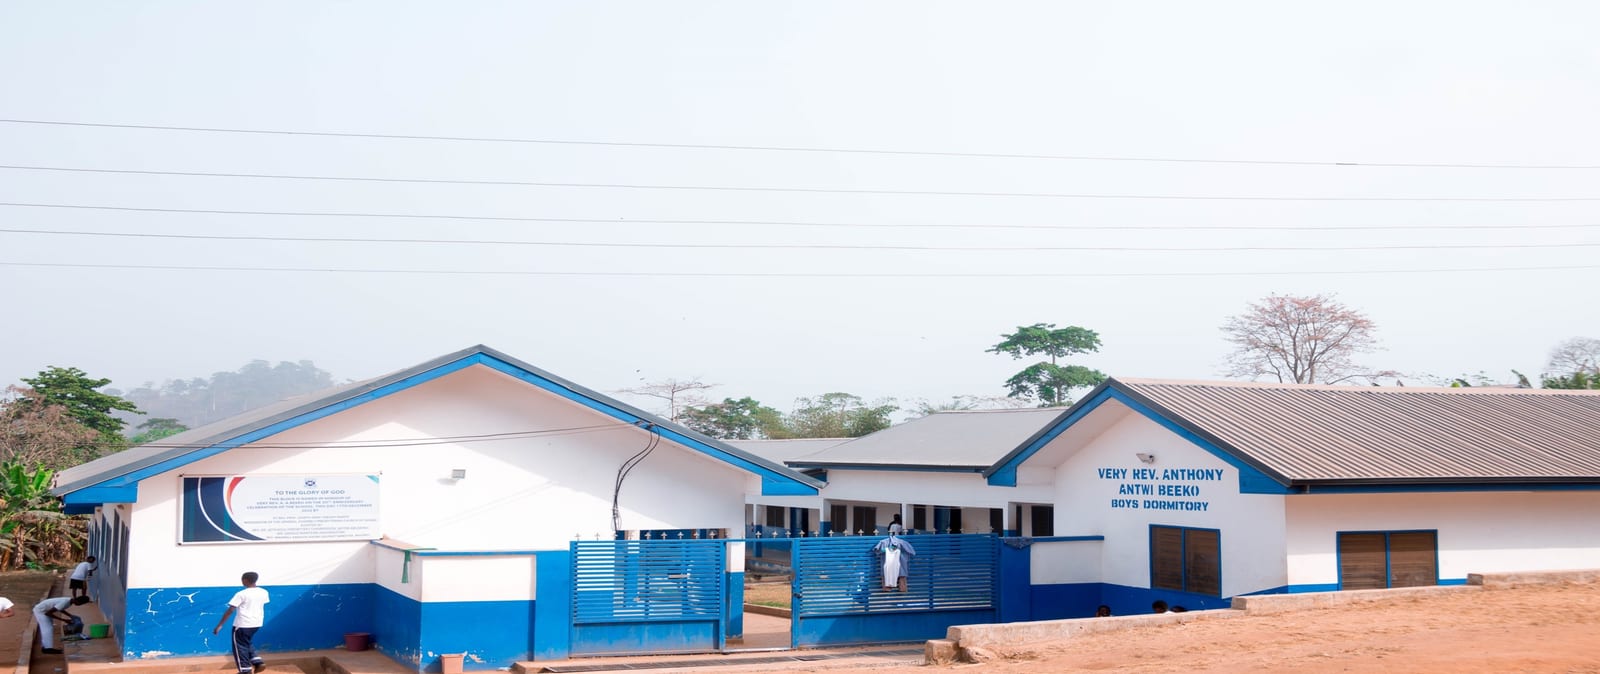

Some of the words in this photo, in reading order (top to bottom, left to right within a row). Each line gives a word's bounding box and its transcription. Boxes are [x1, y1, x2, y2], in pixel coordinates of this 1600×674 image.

[1098, 468, 1127, 479] VERY
[1132, 468, 1159, 480] REV.
[1162, 469, 1224, 481] ANTHONY
[1119, 484, 1154, 495] ANTWI
[1158, 485, 1200, 496] BEEKO
[1111, 499, 1139, 509] BOYS
[1143, 500, 1209, 511] DORMITORY
